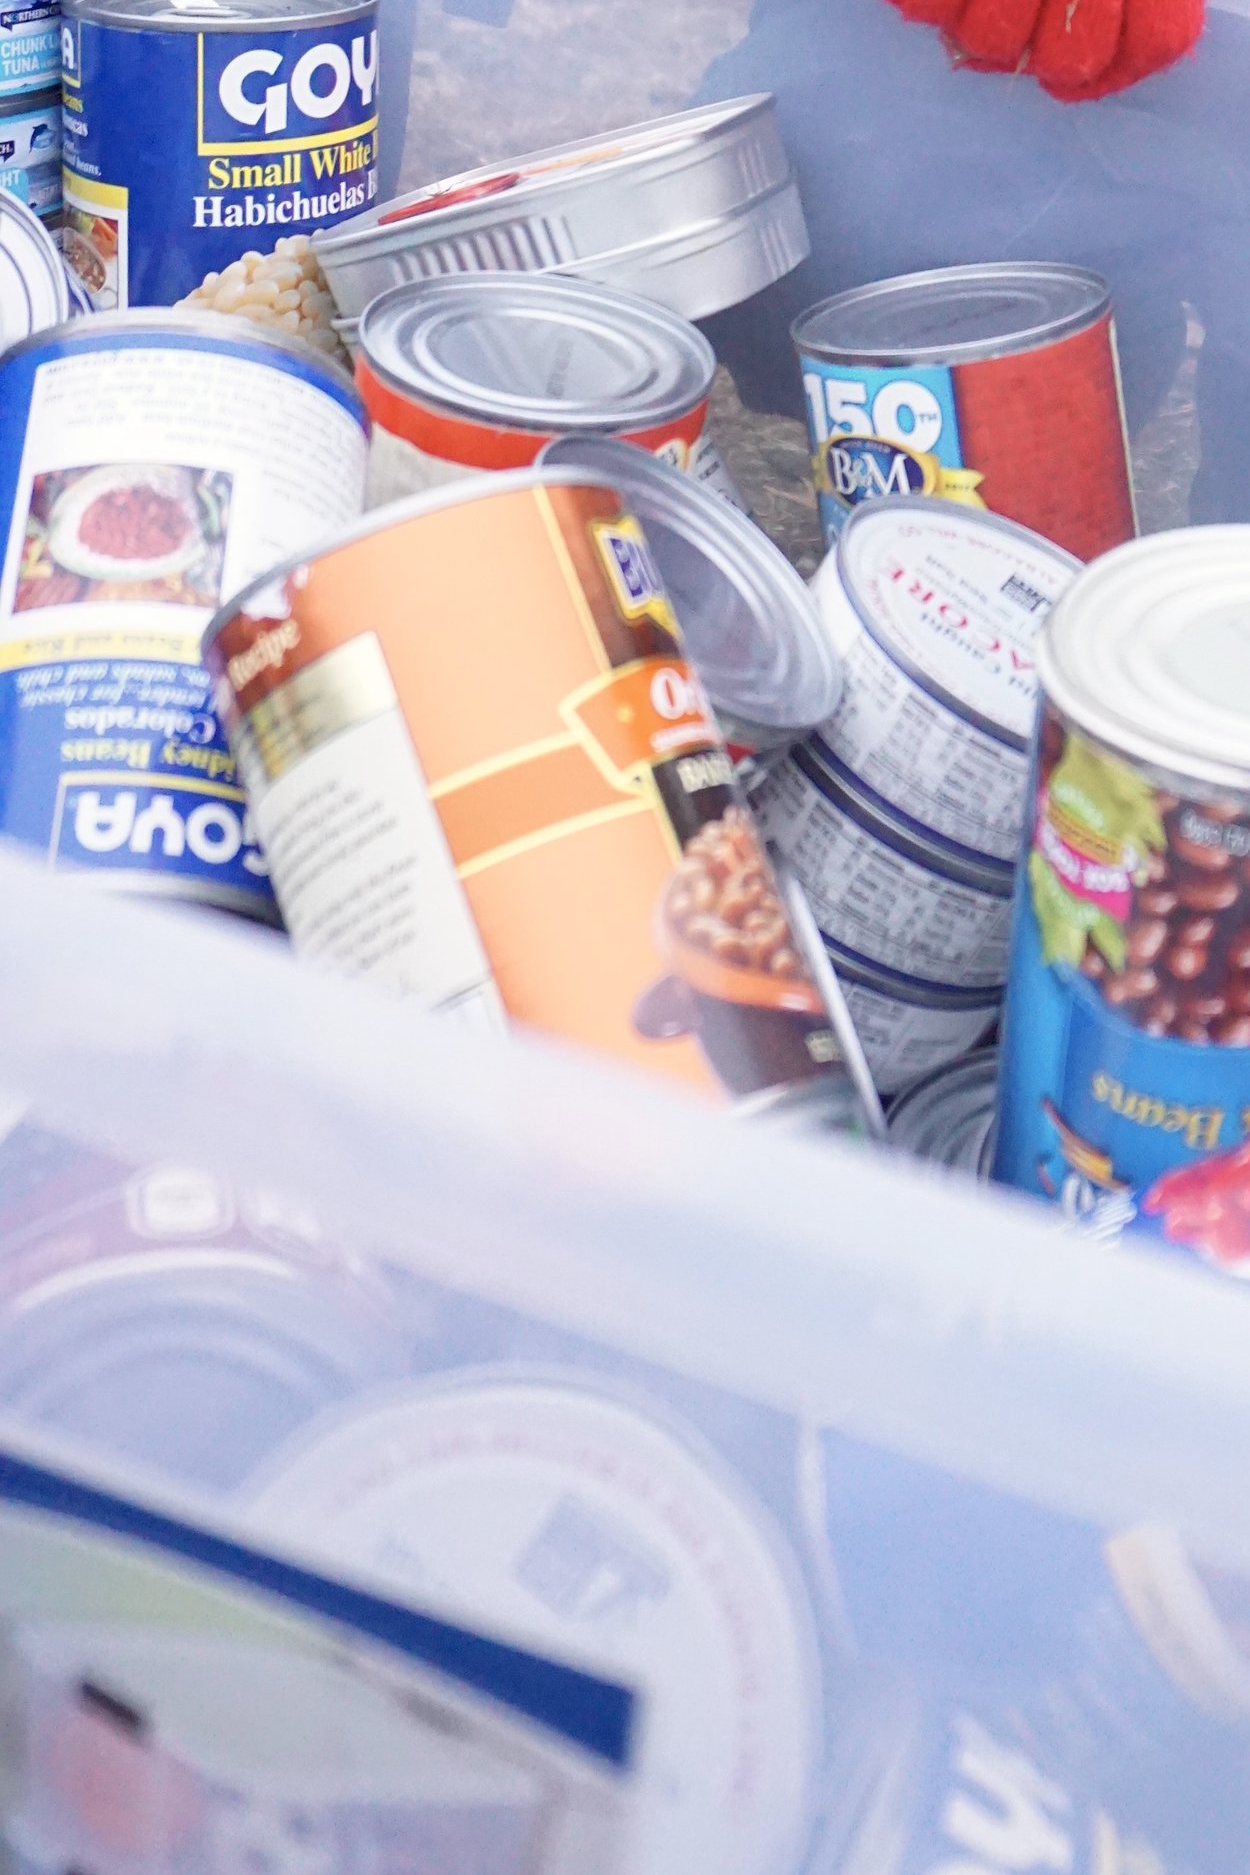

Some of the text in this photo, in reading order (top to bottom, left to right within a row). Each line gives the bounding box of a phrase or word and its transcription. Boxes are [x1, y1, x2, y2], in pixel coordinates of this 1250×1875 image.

[1, 37, 47, 59] CHUNK
[3, 54, 40, 75] TUNA
[208, 139, 371, 190] Small White
[192, 181, 365, 228] Habichuelas
[802, 372, 943, 454] 150
[64, 704, 218, 745] Colorados
[60, 737, 152, 770] Beans
[1092, 1071, 1227, 1150] Beans
